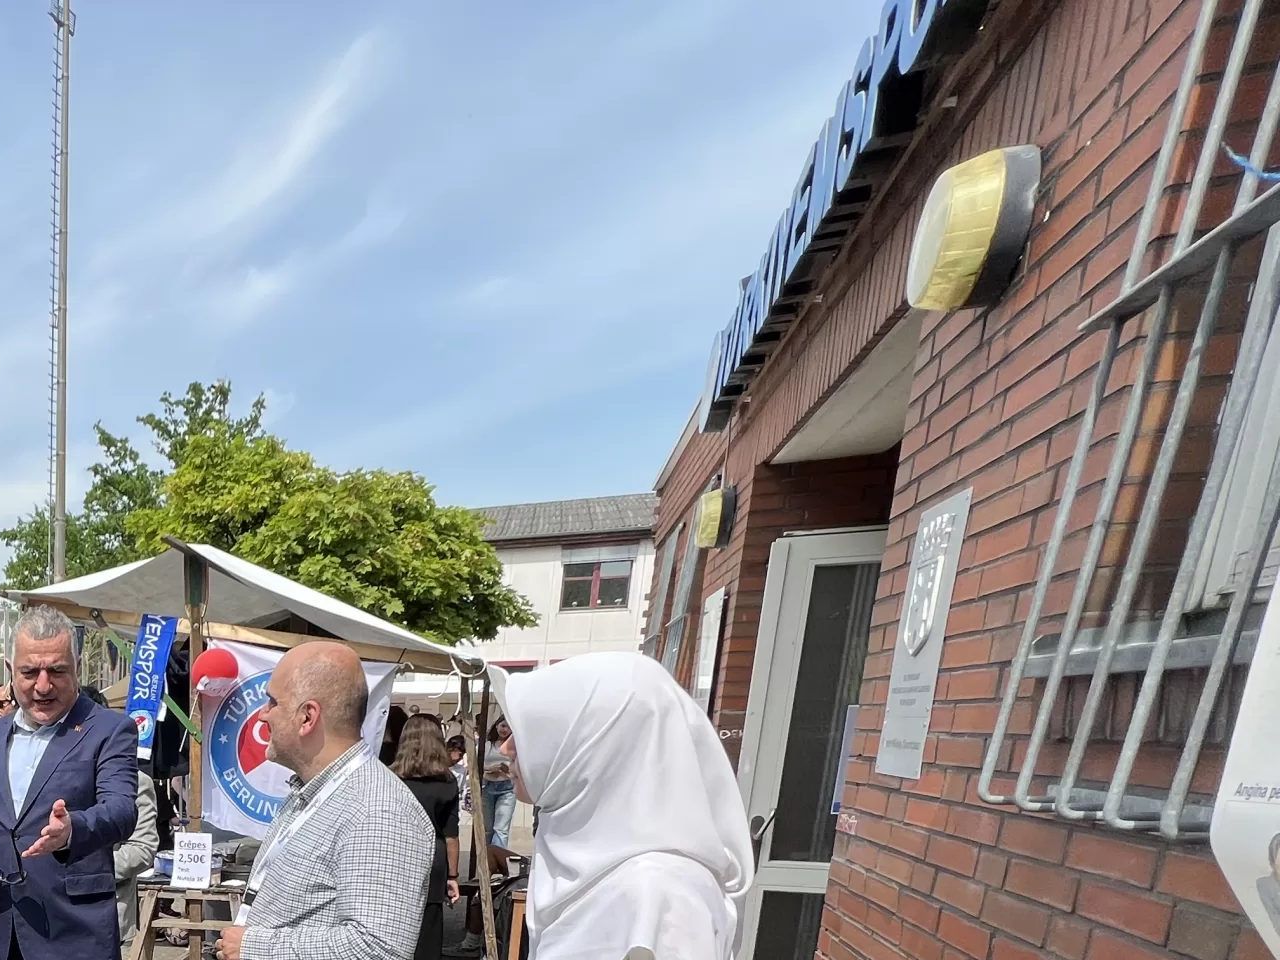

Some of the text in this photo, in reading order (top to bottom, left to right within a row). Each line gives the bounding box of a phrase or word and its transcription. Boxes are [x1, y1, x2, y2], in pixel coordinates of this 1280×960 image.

[150, 674, 160, 701] BERLIN
[223, 766, 280, 818] BERLIN
[1233, 782, 1269, 800] Angina
[178, 840, 207, 849] Crêpes
[178, 853, 206, 864] 2,50€
